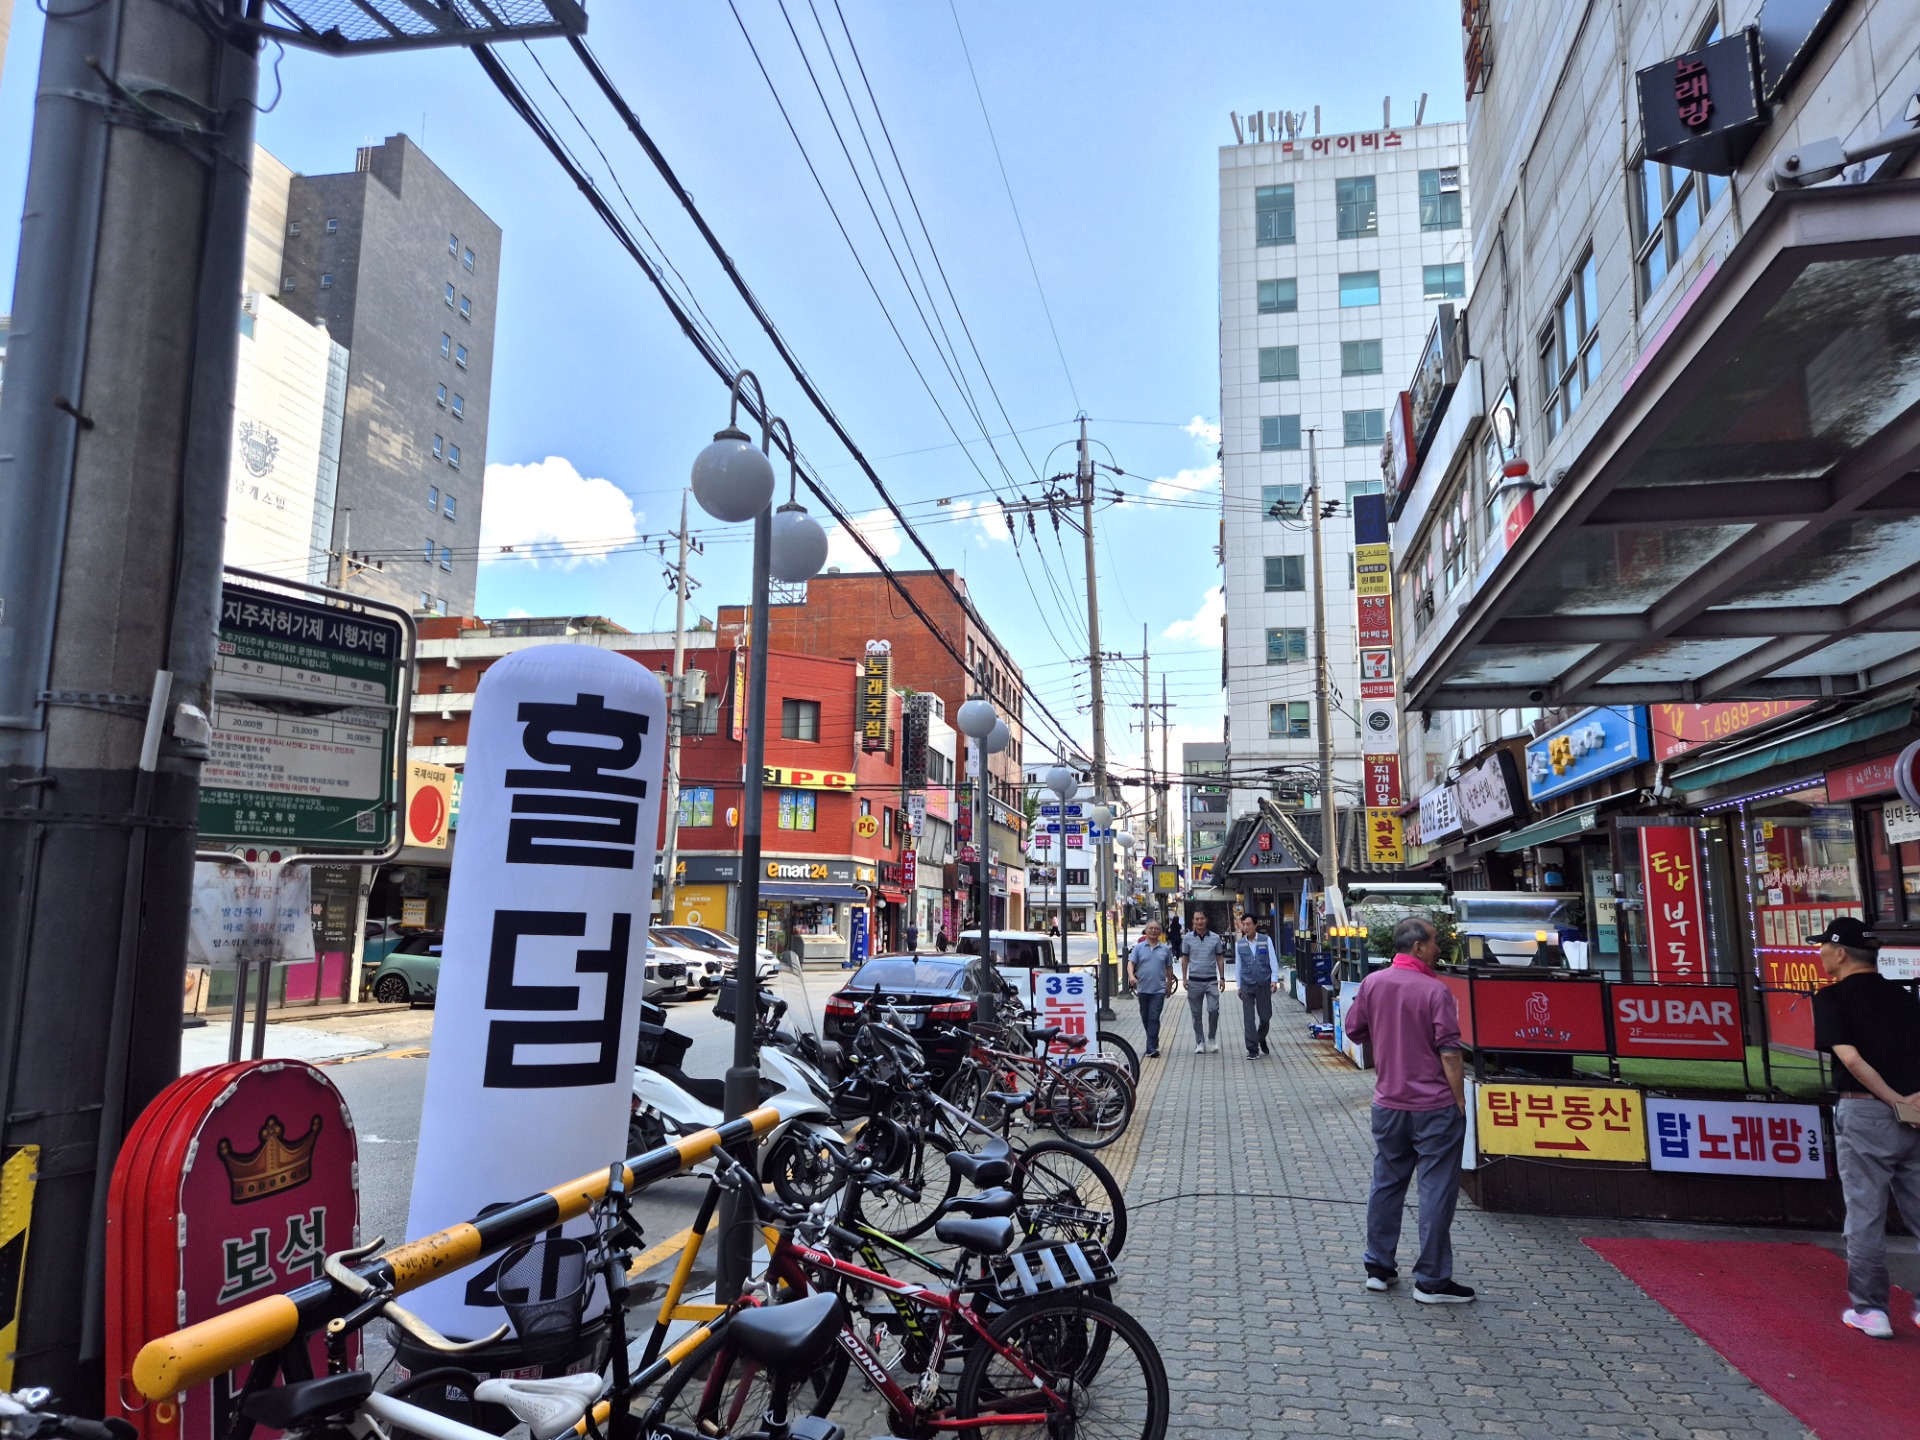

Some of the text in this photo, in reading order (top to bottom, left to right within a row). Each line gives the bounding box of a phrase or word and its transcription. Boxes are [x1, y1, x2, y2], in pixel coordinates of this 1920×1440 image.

[1675, 57, 1712, 126] 노래방
[1311, 131, 1401, 155] 아이비스
[225, 633, 265, 647] 주거지주차
[329, 623, 387, 655] 시행지역
[237, 645, 260, 657] 되오니
[263, 650, 300, 664] 유의하시기
[1367, 653, 1386, 679] 7
[865, 658, 883, 737] 노래주점
[233, 718, 263, 730] 20,000원
[291, 725, 319, 737] 23,000원
[413, 767, 446, 783] 국제식대대
[1373, 765, 1390, 805] 찌개마을
[782, 794, 792, 823] 바둑이
[801, 795, 811, 825] 바둑이
[858, 822, 875, 833] PC
[767, 862, 828, 879] emart24
[483, 693, 650, 1089] 홀덤
[221, 906, 300, 918] 발견즉시 고없이
[1045, 976, 1085, 996] 3층
[1629, 1027, 1642, 1036] 2F
[1487, 1090, 1632, 1132] 탑부동산
[217, 1206, 327, 1305] 보석
[803, 1250, 821, 1262] 200
